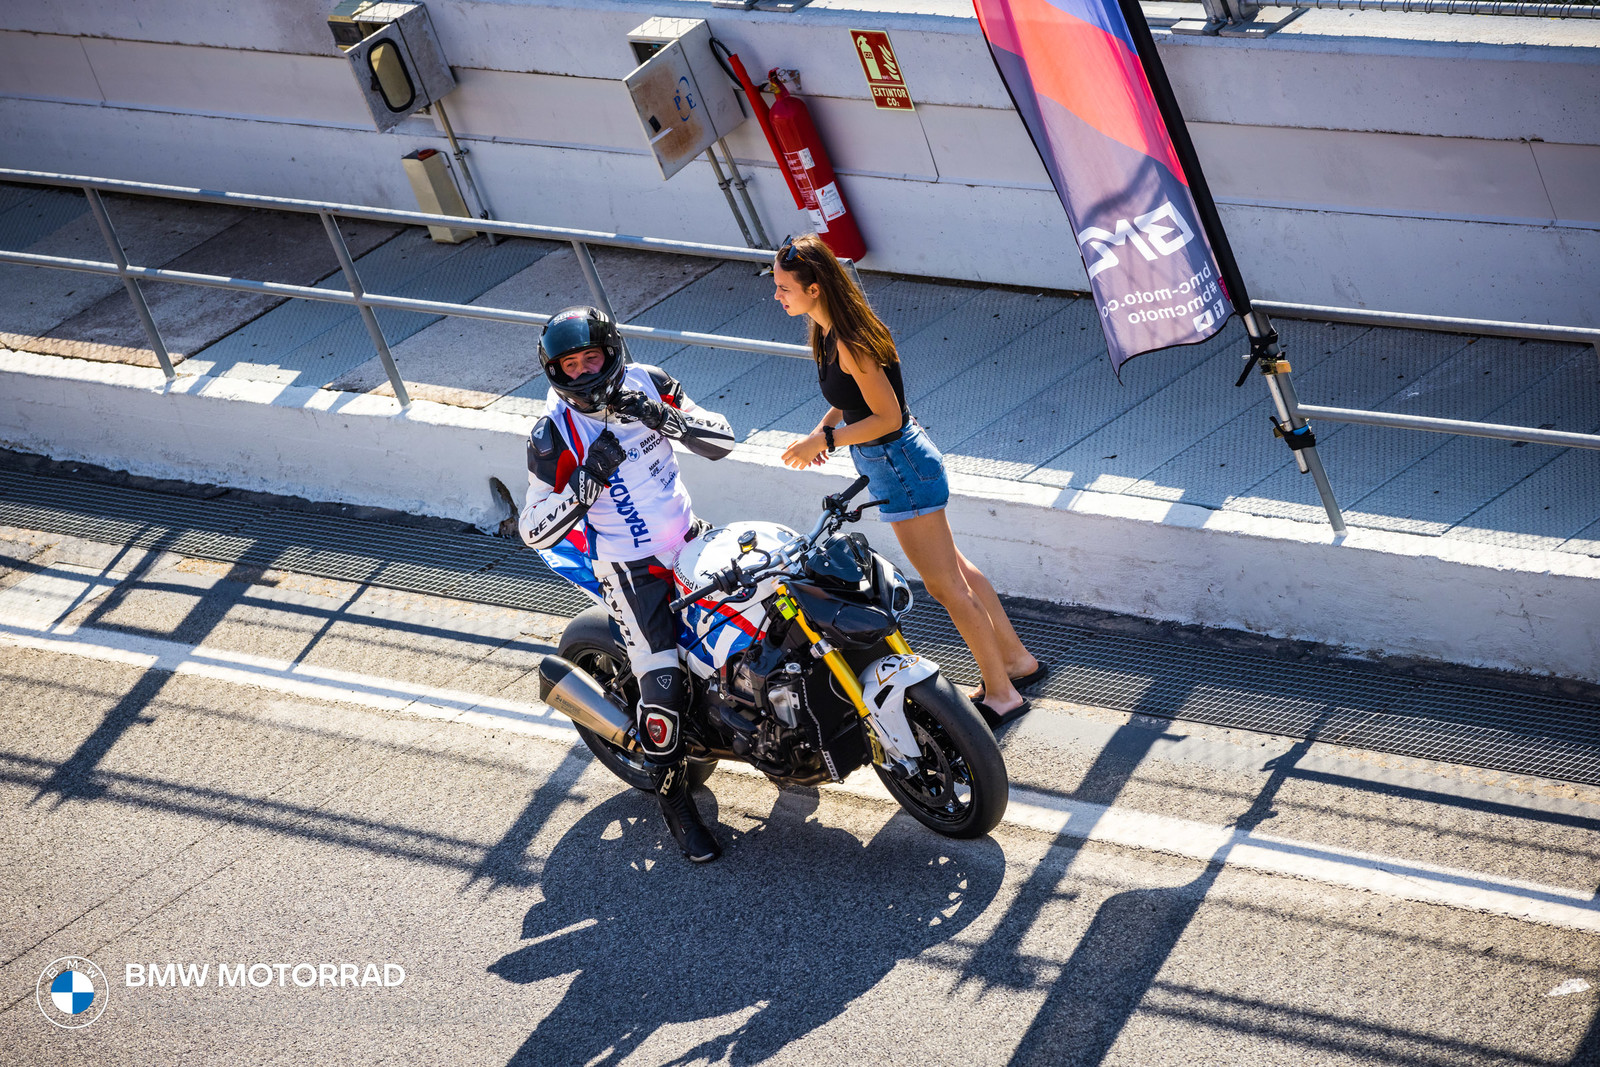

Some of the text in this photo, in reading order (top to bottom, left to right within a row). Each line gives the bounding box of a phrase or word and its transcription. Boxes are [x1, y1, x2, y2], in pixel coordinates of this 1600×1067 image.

[350, 51, 361, 61] TV
[872, 87, 908, 98] EXTINTOR
[640, 433, 656, 448] BMW
[660, 767, 675, 796] TCX
